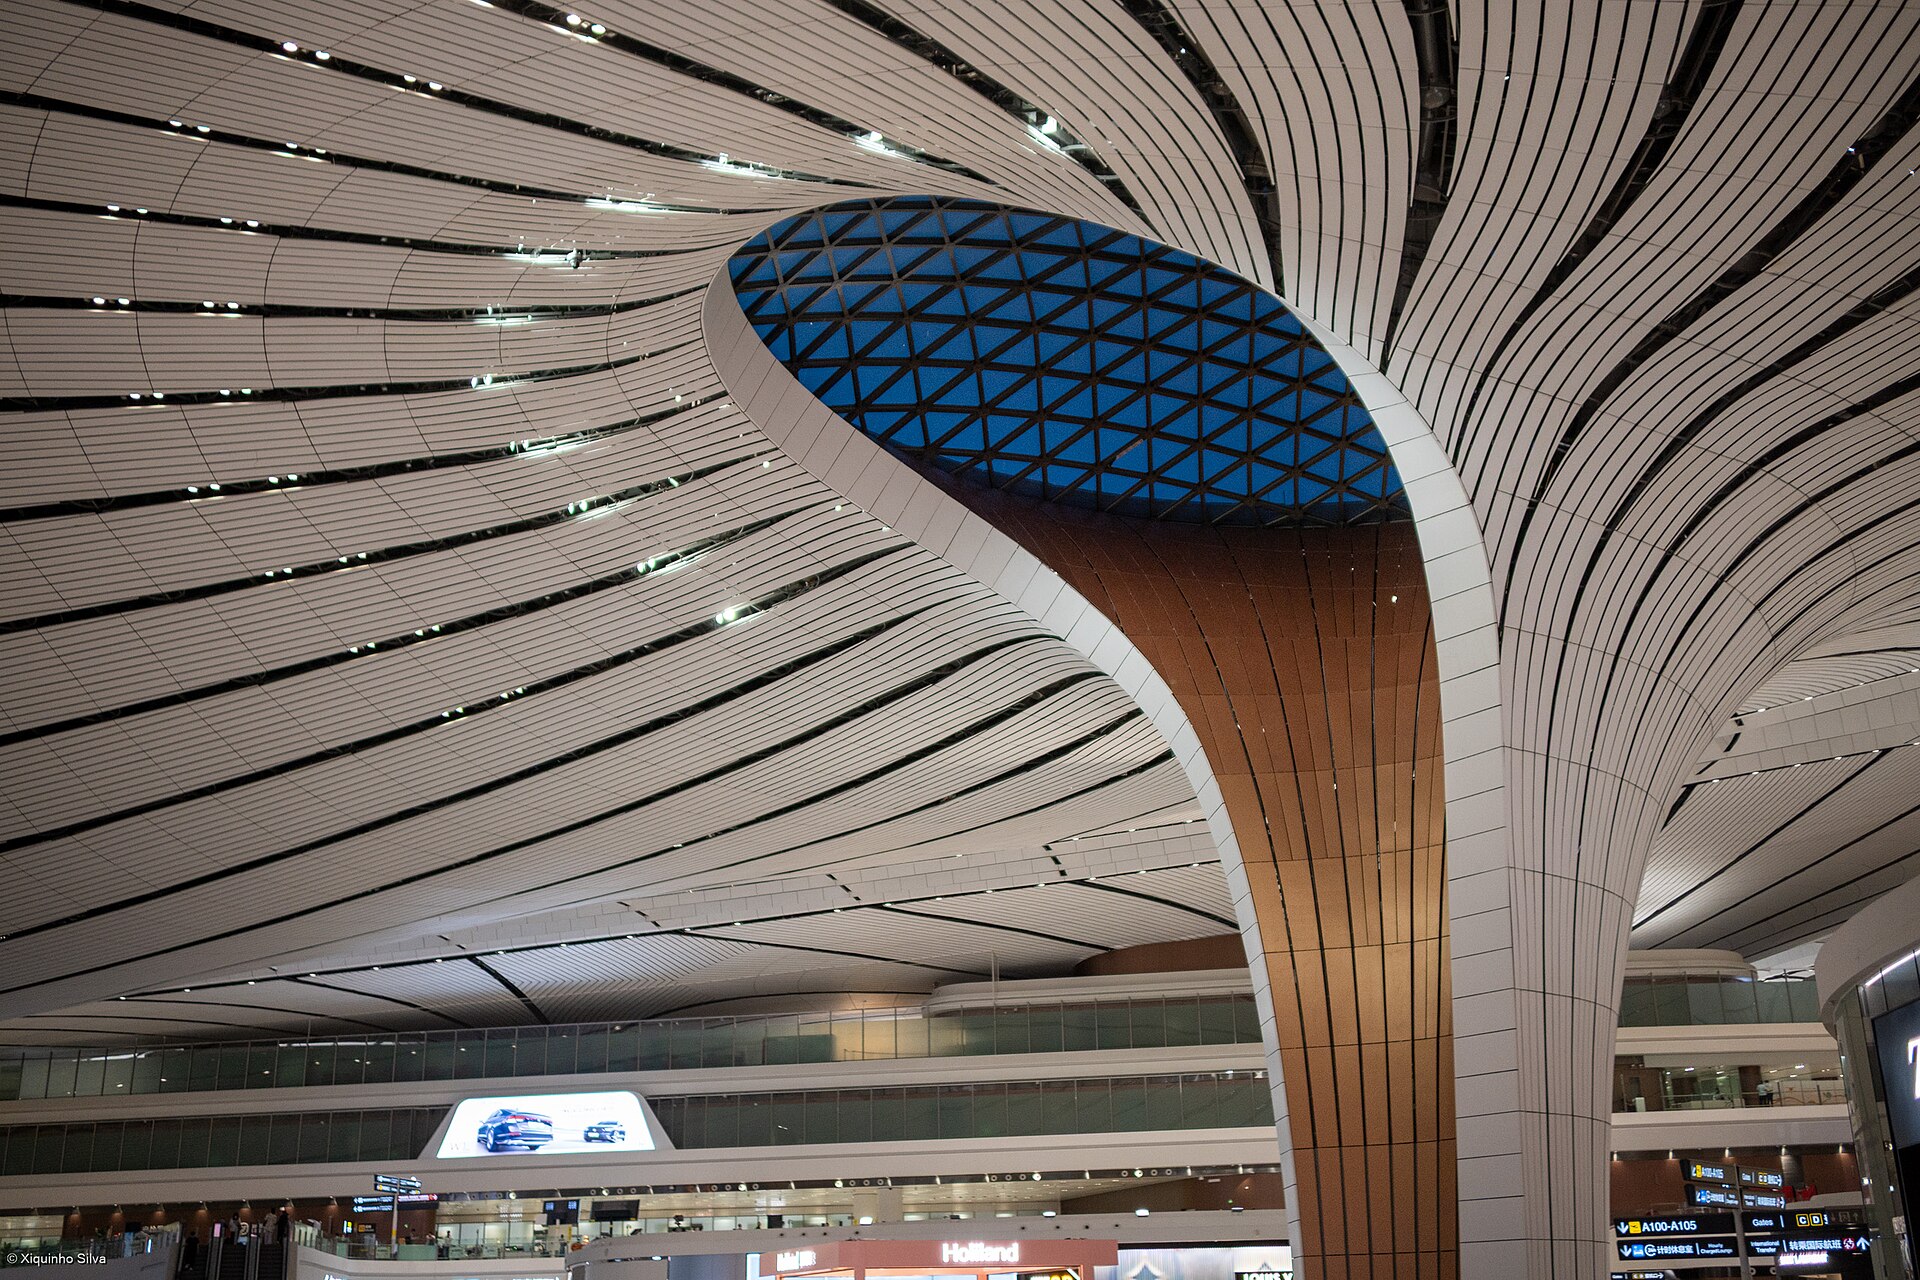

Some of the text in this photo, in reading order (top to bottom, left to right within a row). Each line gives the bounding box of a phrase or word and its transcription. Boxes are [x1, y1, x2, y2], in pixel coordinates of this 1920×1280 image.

[1752, 1218, 1774, 1227] Gates
[1799, 1216, 1807, 1225] C
[1812, 1215, 1820, 1224] D
[1642, 1220, 1697, 1232] A100-A105
